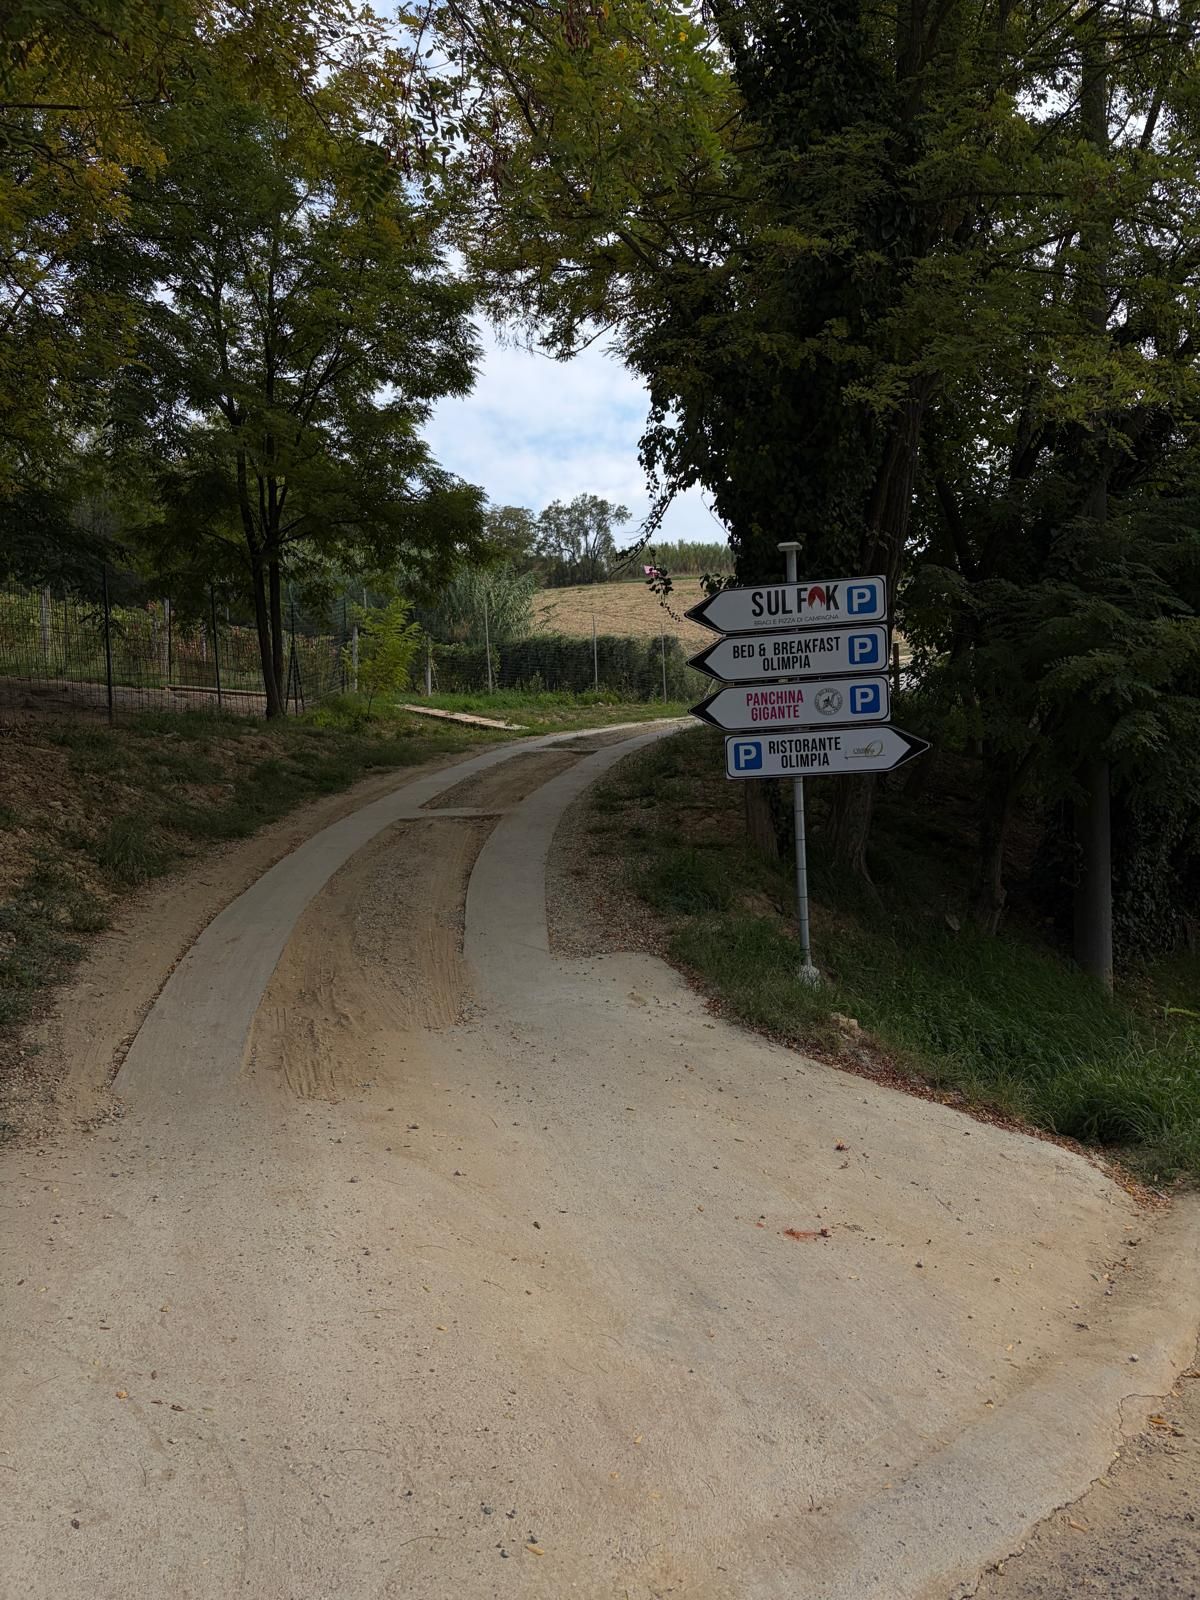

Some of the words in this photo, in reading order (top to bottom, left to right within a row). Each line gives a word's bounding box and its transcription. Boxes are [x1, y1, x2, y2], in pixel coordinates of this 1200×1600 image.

[852, 587, 871, 612] P
[778, 617, 795, 625] PIZZA
[804, 613, 839, 622] CAMPAGNA
[732, 643, 755, 659] BED
[758, 642, 766, 657] &
[773, 636, 840, 656] BREAKFAST
[854, 637, 873, 662] P
[762, 654, 811, 672] OLIMPIA
[746, 688, 804, 707] PANCHINA
[855, 687, 875, 712] P
[751, 705, 800, 722] GIGANTE
[768, 736, 841, 755] RISTORANTE
[739, 744, 757, 768] P
[781, 754, 830, 769] OLIMPIA
